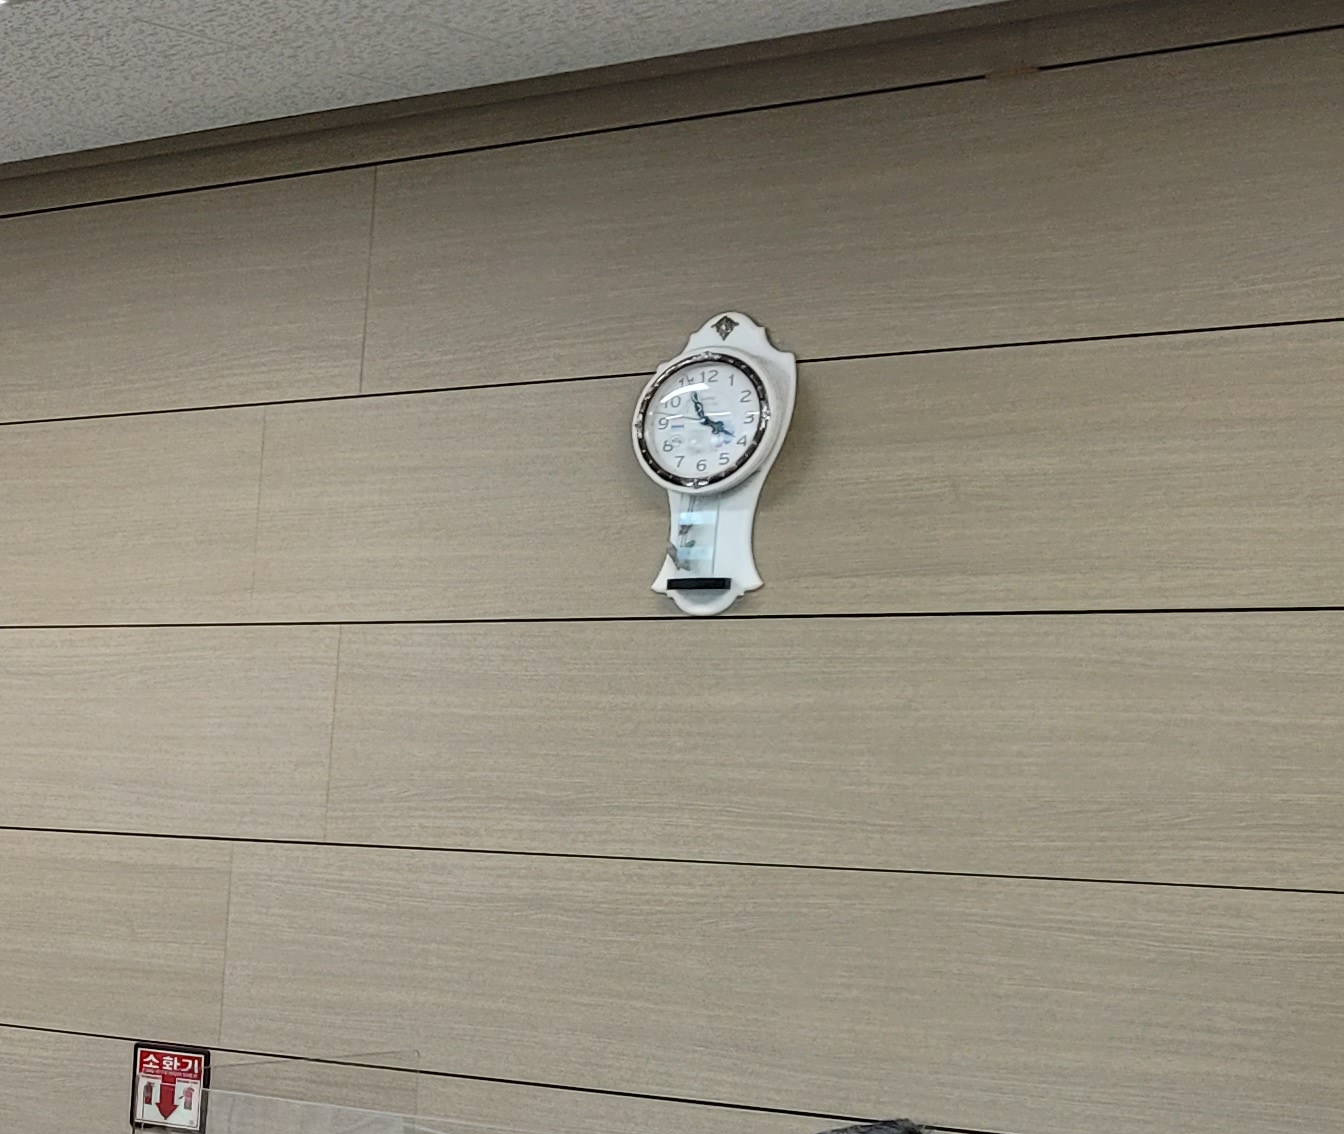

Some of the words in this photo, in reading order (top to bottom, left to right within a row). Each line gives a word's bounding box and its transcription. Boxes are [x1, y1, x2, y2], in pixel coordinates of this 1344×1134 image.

[700, 370, 719, 383] 12
[728, 374, 735, 386] 1
[740, 390, 752, 403] 2
[658, 417, 669, 430] 9
[743, 413, 755, 425] 3
[736, 434, 747, 447] 4
[674, 455, 686, 468] 7
[696, 459, 707, 472] 6
[718, 453, 730, 466] 5
[142, 1054, 200, 1074] 소화기
